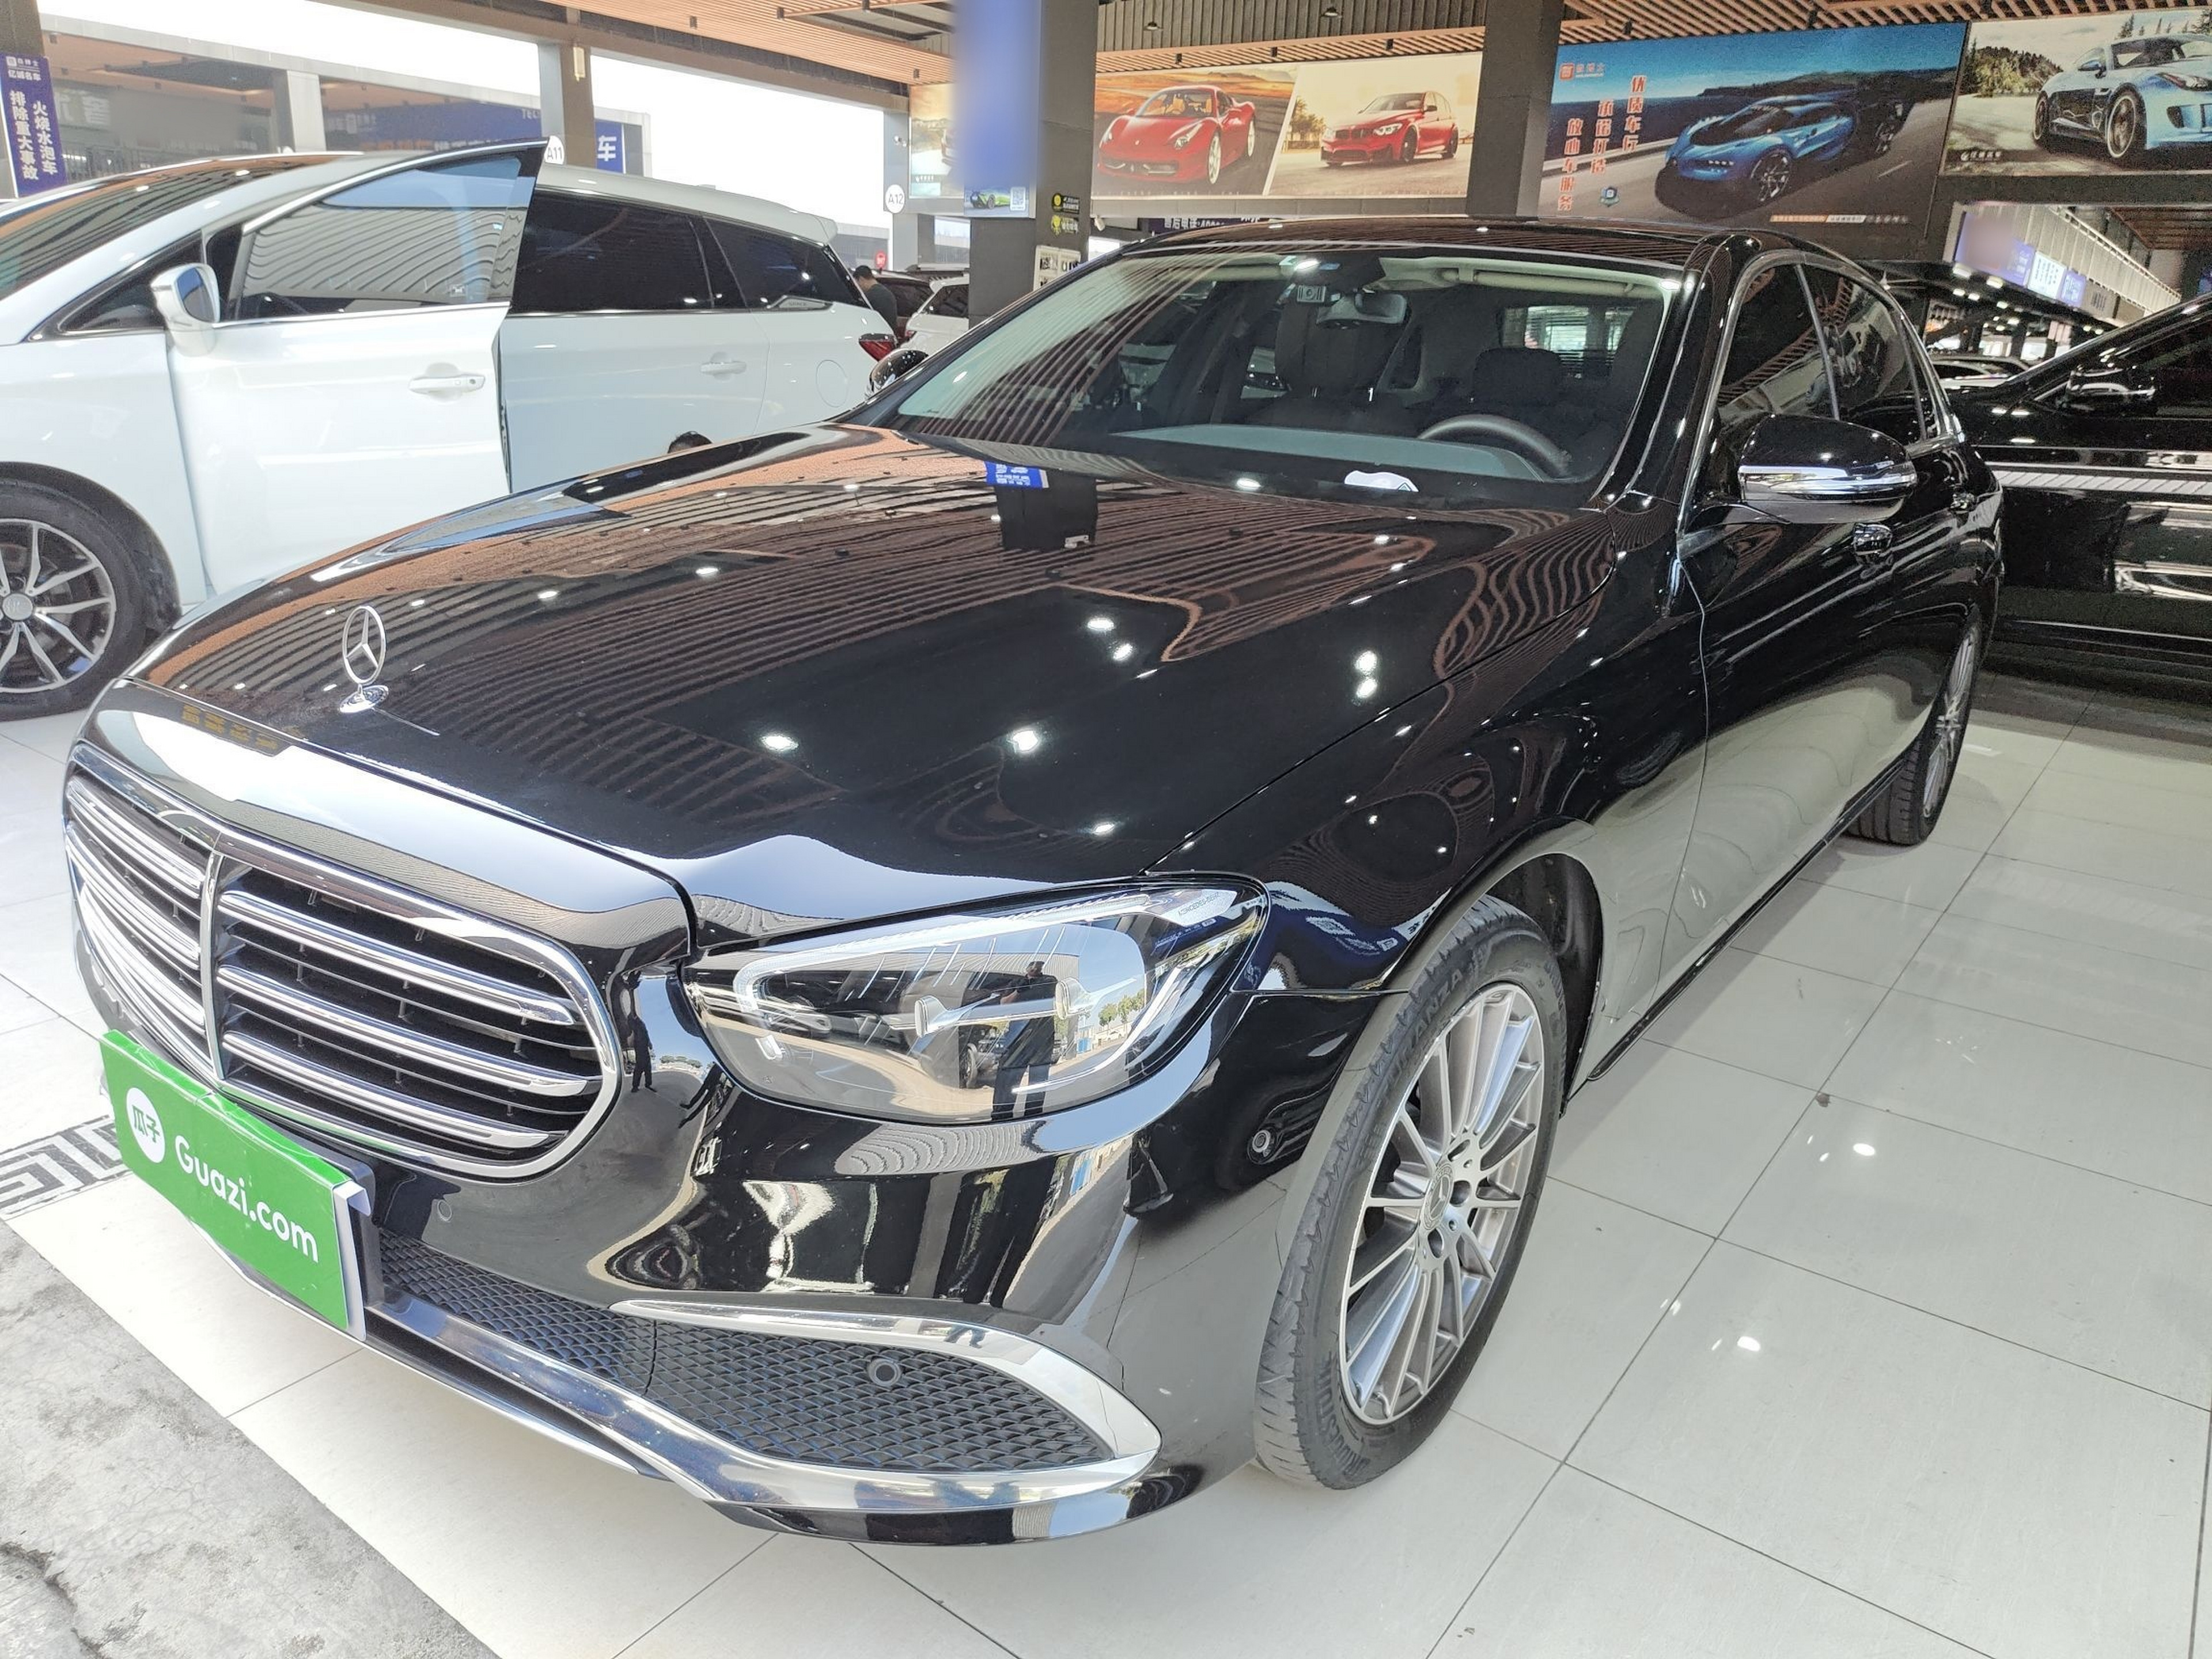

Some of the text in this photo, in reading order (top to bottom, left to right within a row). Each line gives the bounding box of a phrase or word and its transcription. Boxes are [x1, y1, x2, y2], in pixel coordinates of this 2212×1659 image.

[9, 90, 39, 181] 排除重大事故
[33, 100, 58, 175] 火烧水泡车
[547, 146, 562, 160] A11
[597, 135, 618, 161] 车
[888, 193, 904, 204] A12
[132, 1104, 161, 1143] 瓜子
[175, 1135, 319, 1263] Guazi.com
